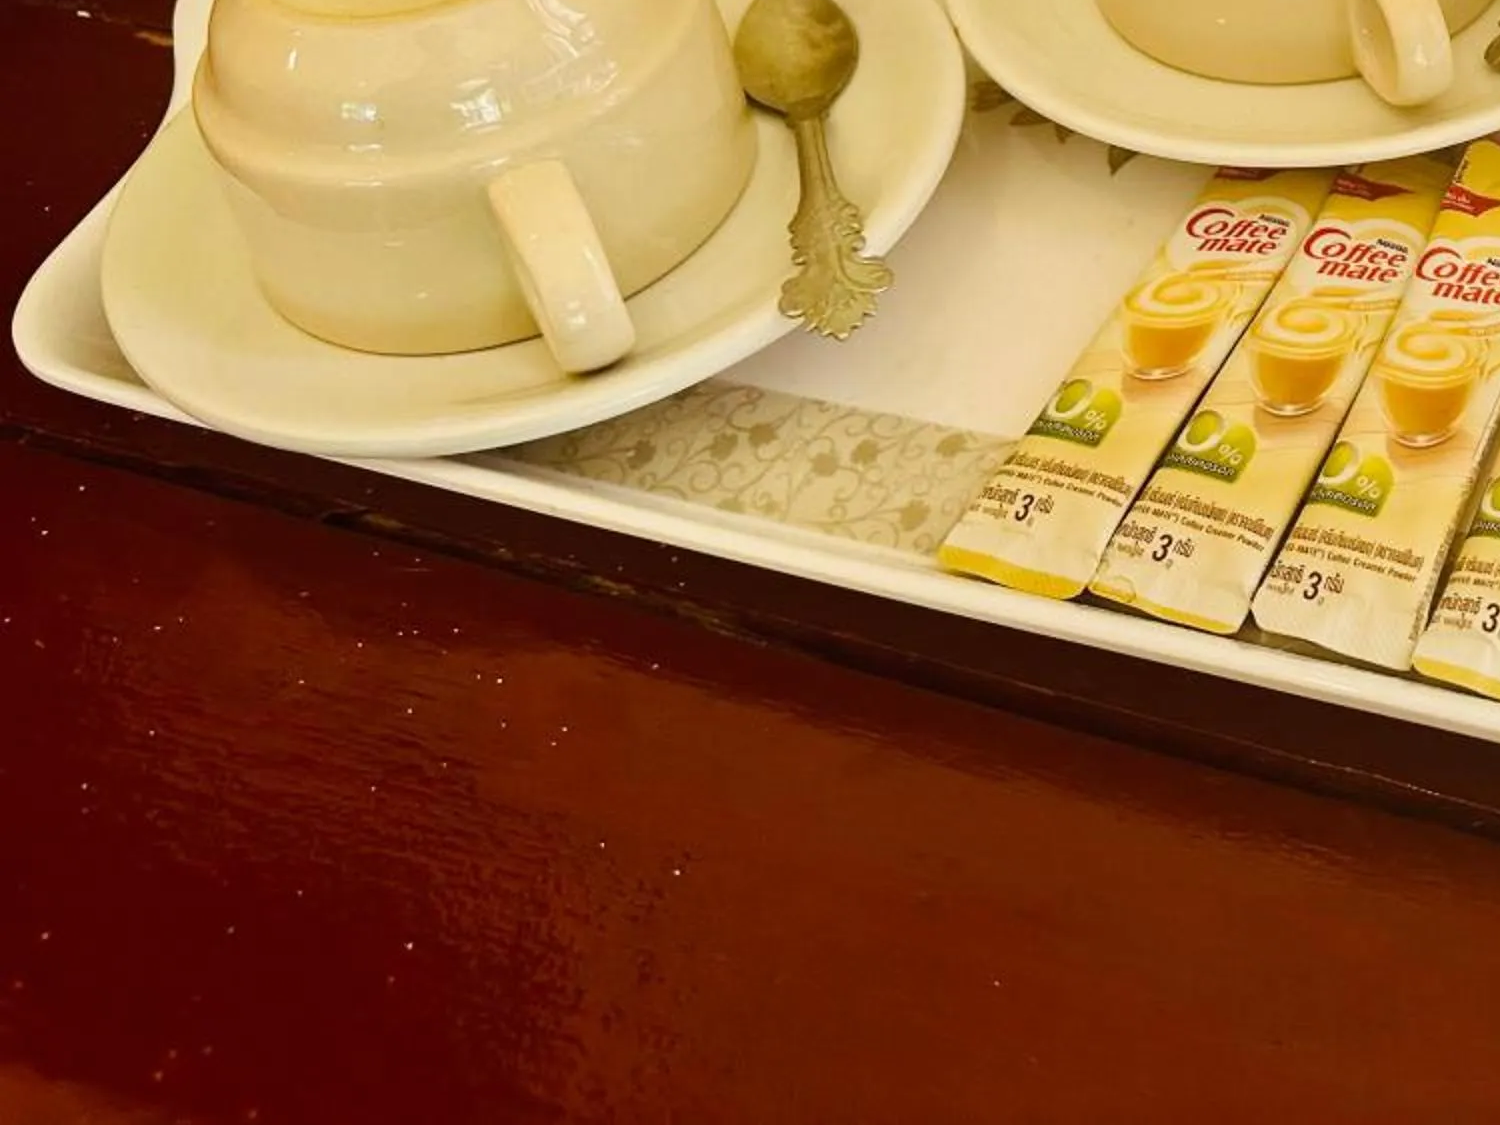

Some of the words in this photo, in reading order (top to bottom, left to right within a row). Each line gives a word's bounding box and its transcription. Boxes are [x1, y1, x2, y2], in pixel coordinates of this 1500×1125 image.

[1185, 208, 1287, 240] Coffee
[1196, 238, 1277, 255] mate
[1303, 226, 1407, 267] Coffee
[1316, 260, 1398, 284] mate
[1177, 408, 1243, 466] 0%
[1014, 494, 1035, 522] 3
[1152, 533, 1173, 562] 3
[1303, 571, 1323, 600] 3
[1482, 602, 1500, 633] 3
